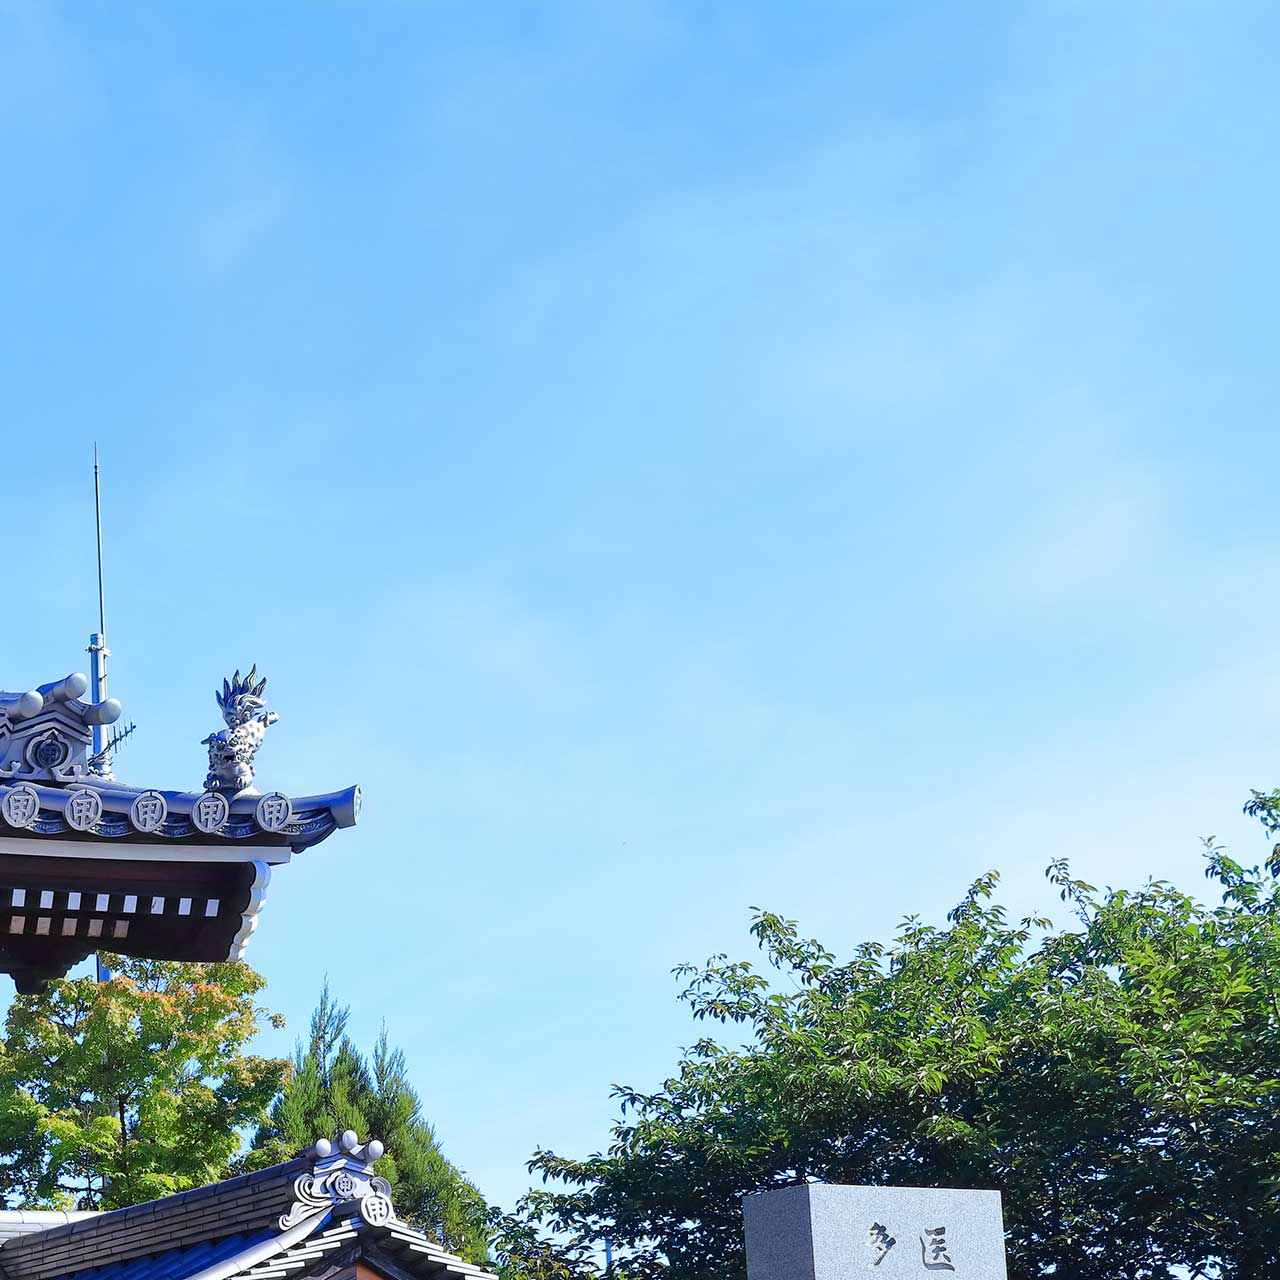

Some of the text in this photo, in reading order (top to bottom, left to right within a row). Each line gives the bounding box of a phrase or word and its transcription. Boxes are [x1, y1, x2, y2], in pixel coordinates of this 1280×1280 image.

[72, 799, 97, 827] 甲
[136, 801, 160, 829] 甲
[199, 802, 223, 830] 甲
[263, 801, 287, 830] 甲
